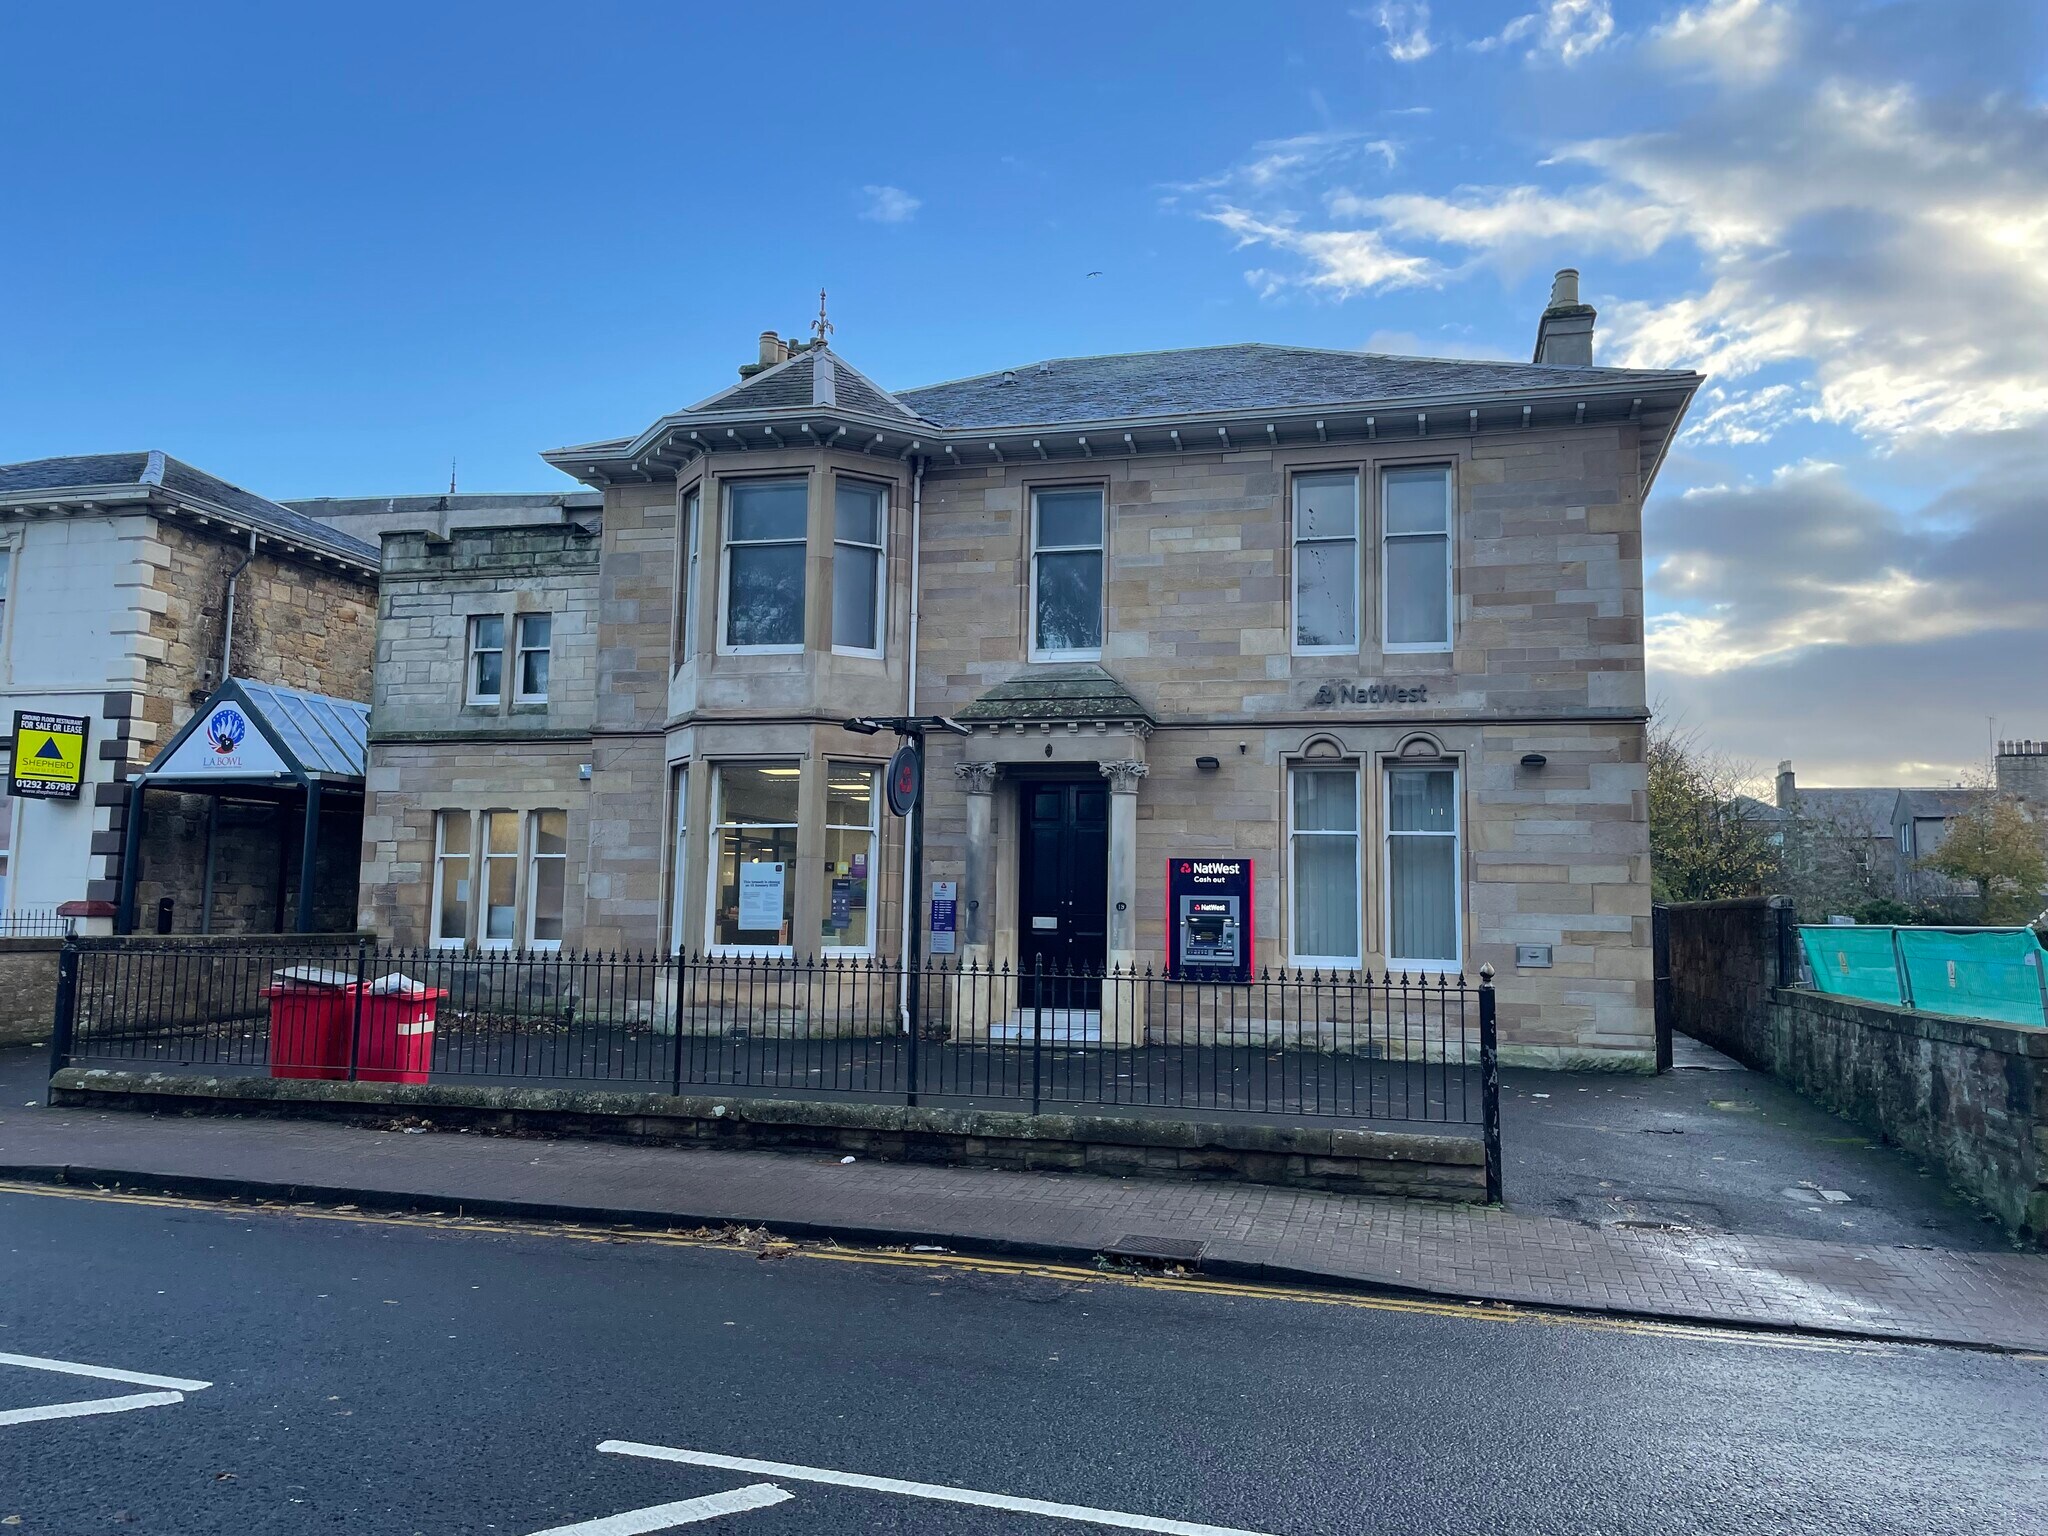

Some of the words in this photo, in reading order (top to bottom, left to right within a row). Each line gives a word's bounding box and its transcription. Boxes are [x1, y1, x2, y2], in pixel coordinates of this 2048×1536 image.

[1340, 684, 1428, 704] NatWest
[21, 720, 34, 729] FOR
[35, 721, 51, 731] SALE
[52, 723, 62, 732] OR
[63, 724, 83, 734] LEASE
[22, 758, 74, 769] SHEPHERD
[217, 757, 242, 766] BOWL
[16, 779, 42, 789] 01292
[45, 782, 76, 791] 267987
[1193, 862, 1240, 874] NatWest
[1193, 875, 1212, 883] Cash
